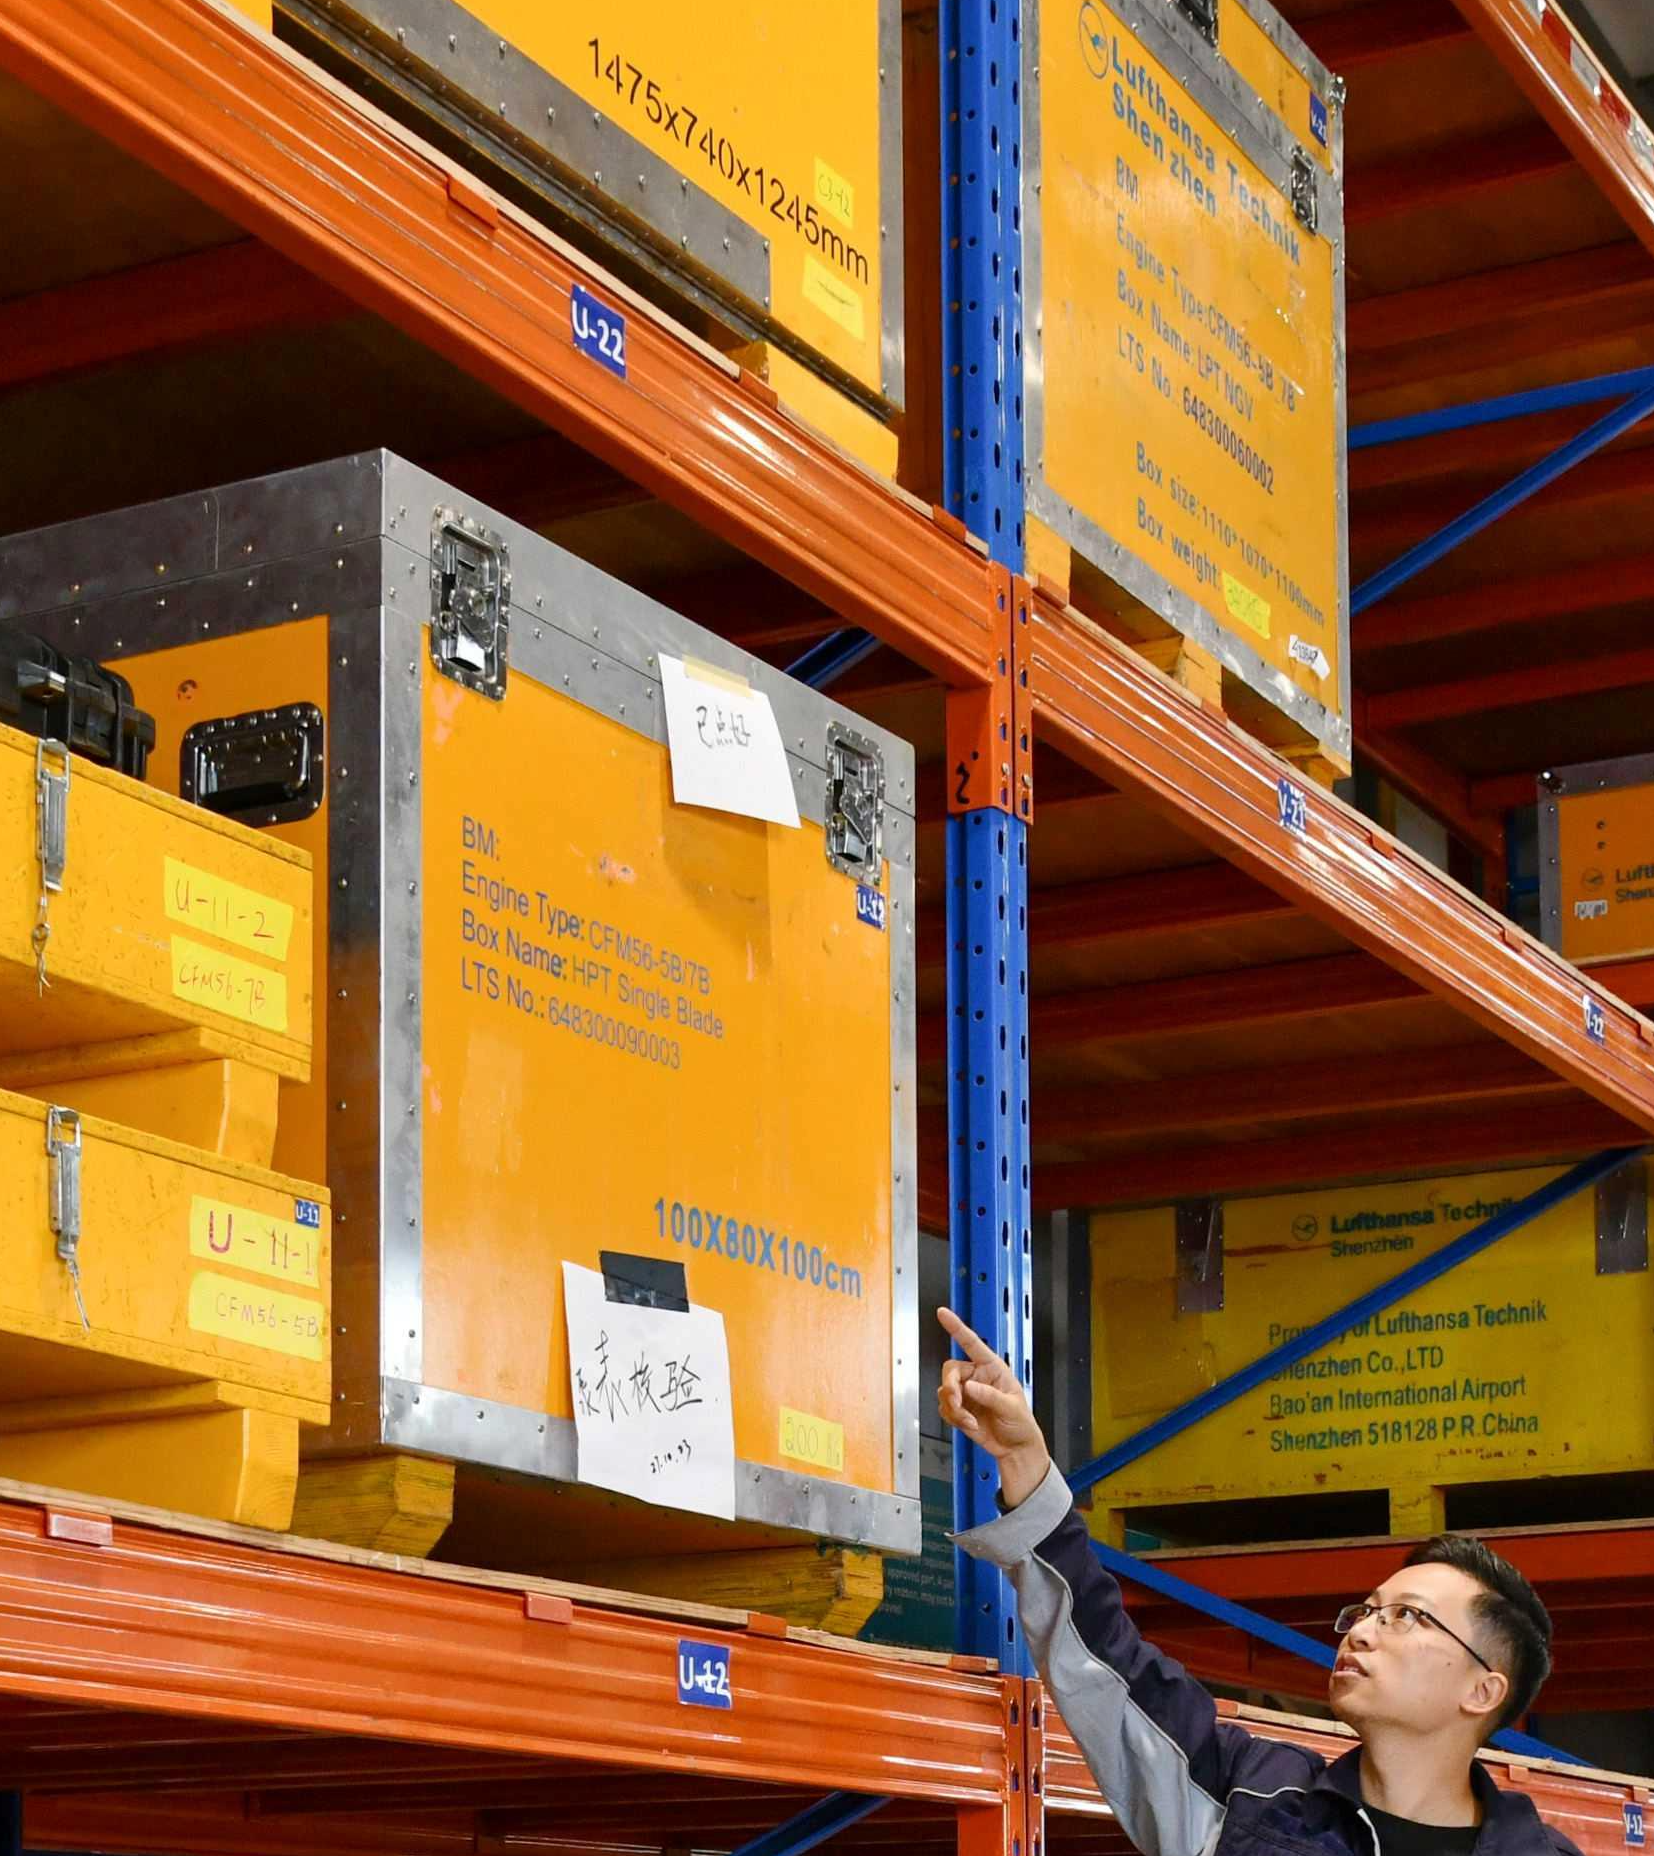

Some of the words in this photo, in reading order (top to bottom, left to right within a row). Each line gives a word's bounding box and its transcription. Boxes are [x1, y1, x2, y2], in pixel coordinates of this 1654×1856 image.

[587, 38, 869, 285] 1475x740x1245mm
[1112, 37, 1215, 174] Lufthansa
[1227, 160, 1300, 266] Technik
[1117, 212, 1165, 284] Engine
[1118, 268, 1144, 319] Box
[571, 306, 625, 367] U-22
[1118, 325, 1144, 373] LTS
[1137, 441, 1162, 488] Box
[1137, 497, 1164, 544] Box
[461, 816, 500, 862] BM:
[461, 860, 529, 917] Engine
[536, 891, 585, 941] Type:
[461, 909, 499, 953] Box
[506, 928, 568, 982] Name:
[572, 953, 611, 995] HPT
[617, 972, 671, 1022] Single
[677, 995, 724, 1039] Blade
[460, 957, 500, 1001] LTS
[506, 978, 546, 1020] No.:
[548, 996, 682, 1071] 648300090003
[295, 1202, 321, 1225] U-11
[1330, 1208, 1434, 1234] Lufthansa
[654, 1197, 863, 1298] 100X80X100cm
[1331, 1235, 1414, 1258] Shenzhen
[1375, 1310, 1470, 1337] Lufthansa
[1474, 1300, 1547, 1326] Technik
[1270, 1390, 1333, 1418] Bao'an
[1339, 1378, 1457, 1410] International
[1462, 1375, 1526, 1403] Airport
[1270, 1427, 1363, 1453] Shenzhen
[1368, 1420, 1438, 1446] 518128
[1624, 1812, 1644, 1836] V-12
